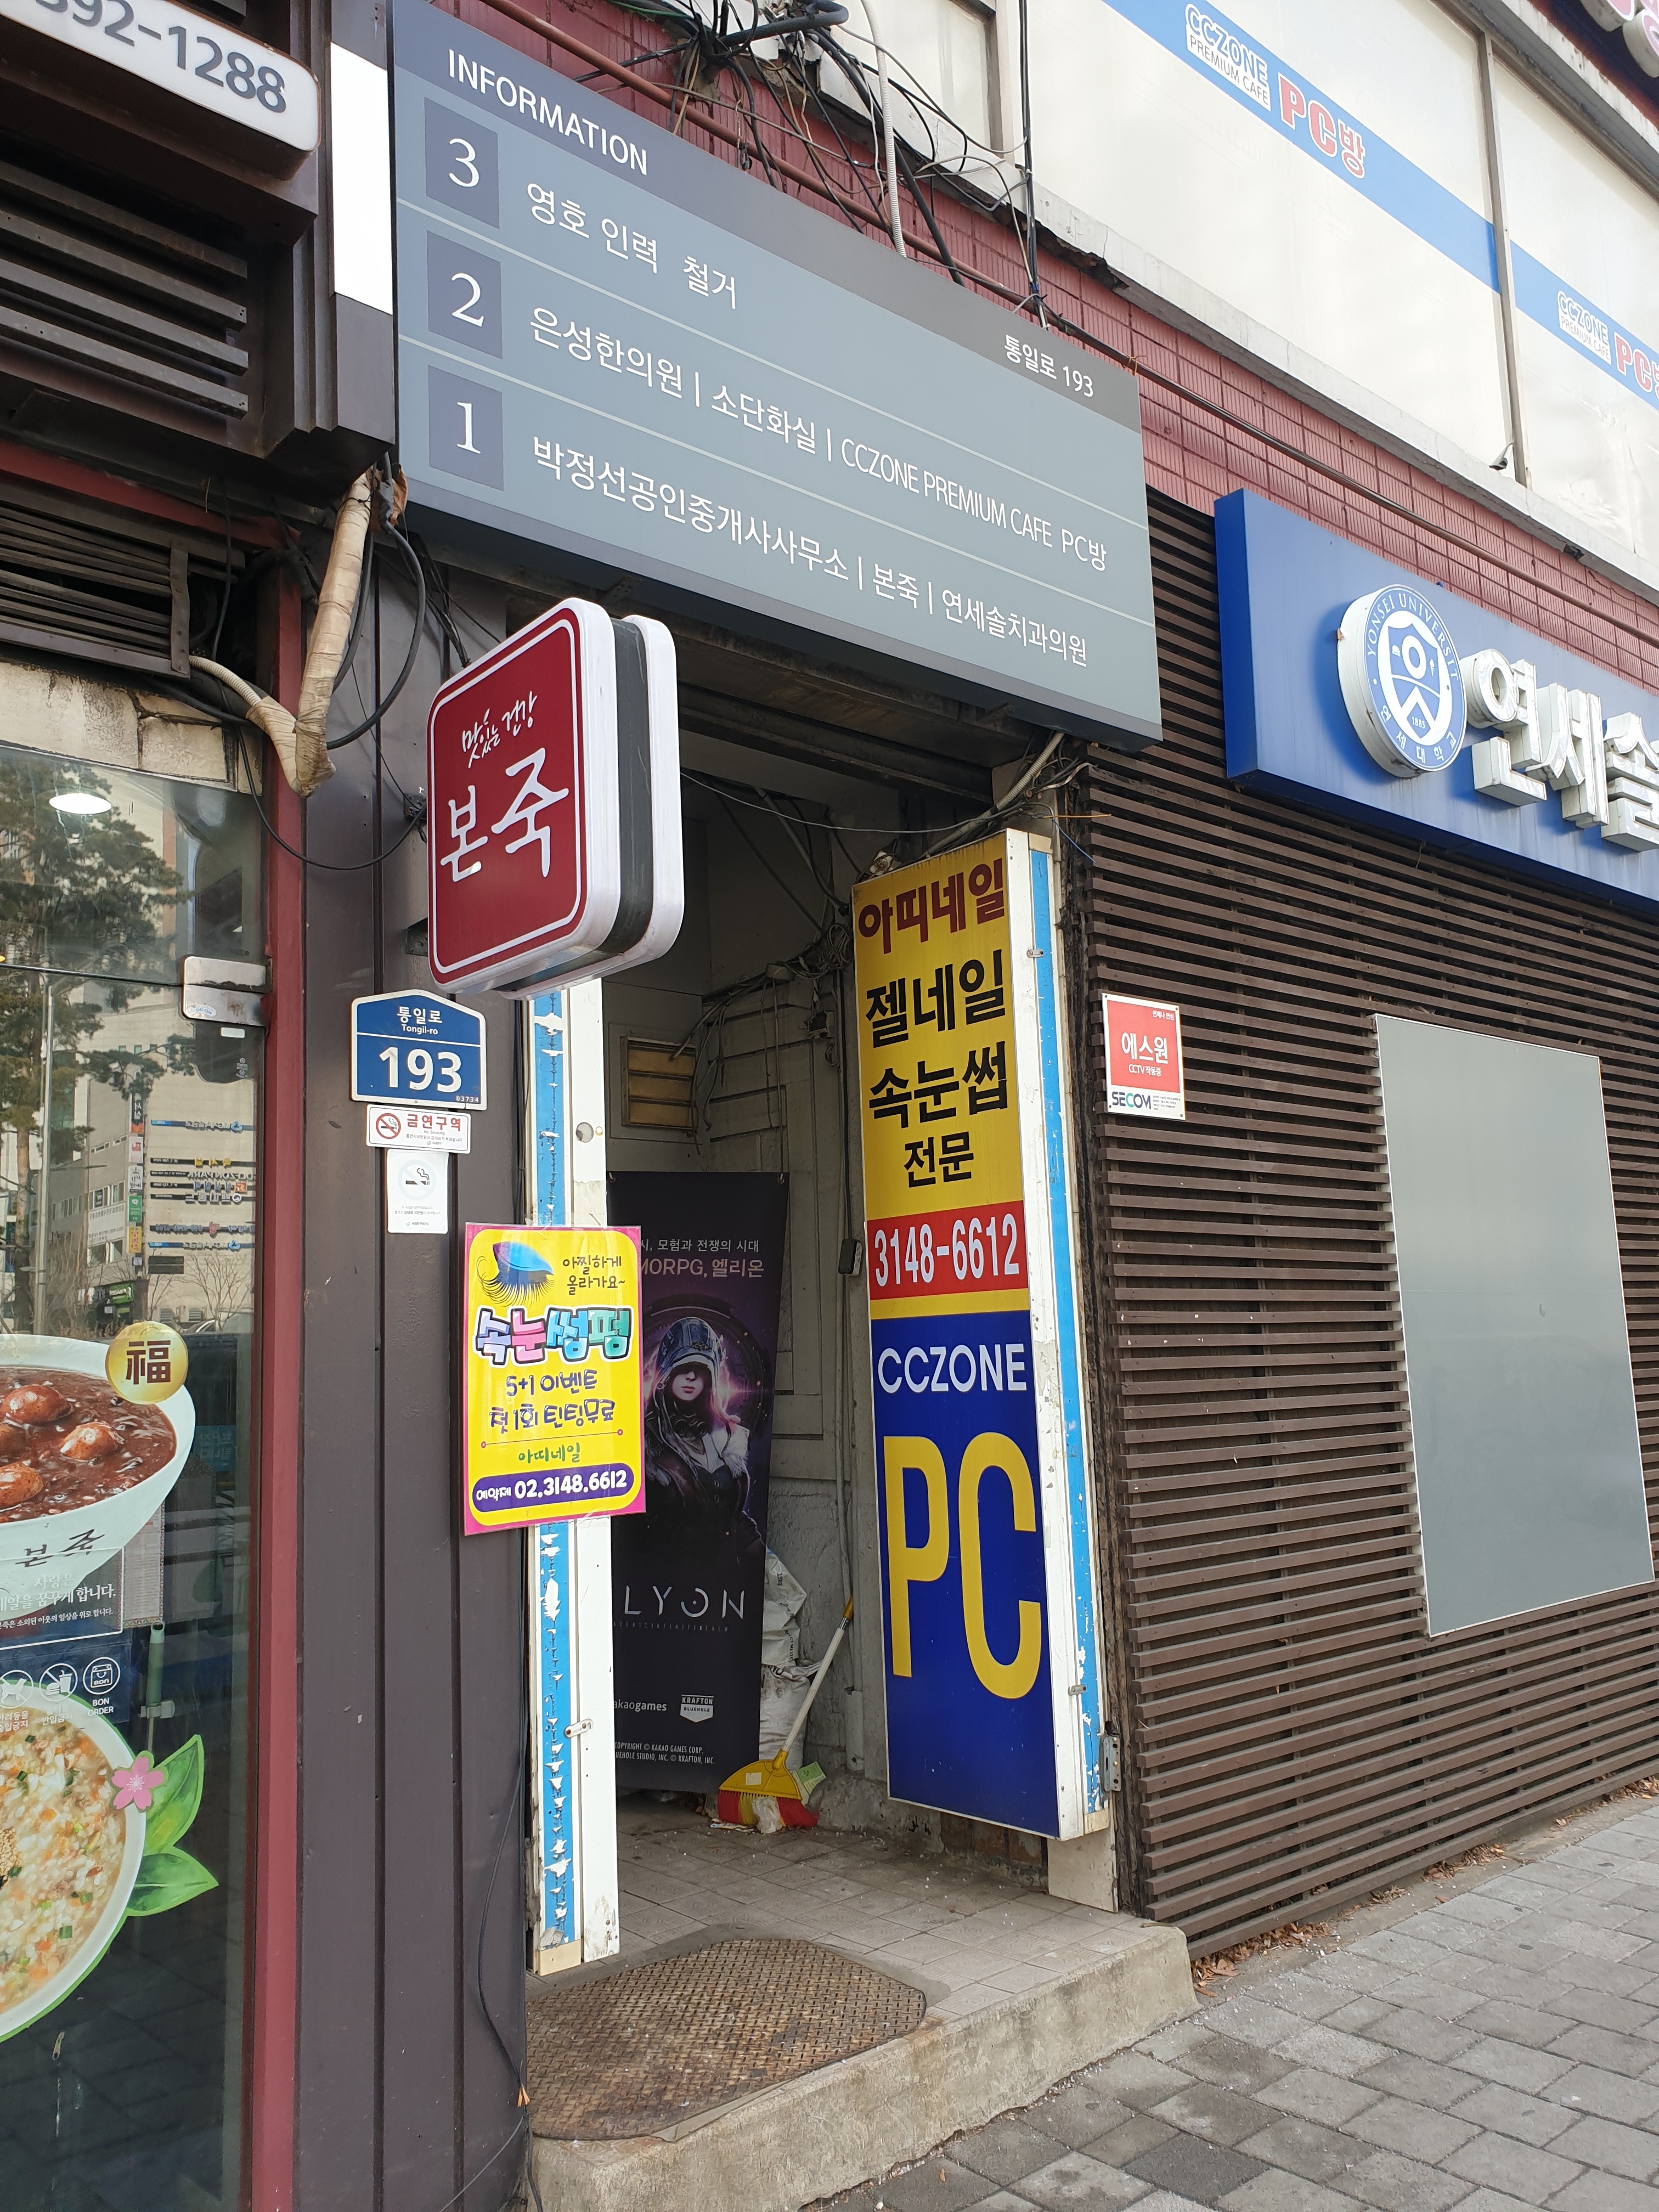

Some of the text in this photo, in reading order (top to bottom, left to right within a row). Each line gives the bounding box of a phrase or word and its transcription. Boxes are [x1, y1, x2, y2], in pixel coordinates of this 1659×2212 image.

[1185, 3, 1268, 88] CCZONE
[1190, 34, 1269, 106] PREMIUM CAFE
[448, 49, 647, 176] INFORMATION
[1278, 72, 1365, 179] PC방
[448, 138, 480, 188] 3
[527, 182, 736, 310] 영호 인력 철거
[451, 272, 485, 327] 2
[1557, 291, 1609, 346] CCZONE
[1561, 315, 1610, 360] PREMIUM CAFE
[1005, 334, 1094, 398] 통일로 193
[456, 402, 481, 454] 1
[530, 308, 1107, 572] 은성한의원 소단화실 CCZONE PREMIUM CAFE PC방
[533, 437, 1087, 668] 박정선공인중개사사무소 본죽 연세솔치과의원
[1367, 594, 1396, 657] YONSEI
[501, 690, 538, 737] 건강
[1380, 704, 1457, 765] 연세대학교
[1412, 716, 1426, 729] 1885
[440, 747, 569, 883] 본죽
[858, 857, 1005, 955] 아띠네일
[397, 1006, 443, 1025] 통일로
[865, 949, 1006, 1048] 젤네일
[1152, 1010, 1175, 1021] 언제나 안심
[401, 1024, 439, 1035] Tongil-ro
[1121, 1031, 1169, 1064] 에스원
[379, 1047, 462, 1093] 193
[868, 1040, 1008, 1130] 속눈썹
[1128, 1063, 1162, 1077] CCTV 작동중
[455, 1095, 479, 1103] 03734
[1111, 1091, 1152, 1110] SECOM
[407, 1113, 461, 1132] 금연구역
[903, 1131, 974, 1189] 전문
[562, 1255, 622, 1275] 아찔하게
[657, 1238, 692, 1251] 모험과
[697, 1239, 731, 1252] 전쟁의
[736, 1240, 759, 1252] 시대
[874, 1213, 1019, 1288] 3148-6612
[567, 1275, 626, 1296] 올라가요~
[712, 1259, 764, 1278] 엘리온
[126, 1340, 172, 1385] 福
[505, 1369, 597, 1397] 5+1 이벤트
[878, 1342, 1028, 1395] CCZONE
[543, 1398, 616, 1429] 틴팅무료
[518, 1442, 581, 1464] 아띠네일
[476, 1469, 627, 1502] 예약제 02.3148.6612
[15, 1528, 105, 1567] 본죽
[883, 1431, 1041, 1701] PC
[16, 1617, 37, 1627] 소외된
[38, 1614, 57, 1624] 이웃의
[58, 1612, 78, 1621] 일상을
[78, 1610, 92, 1619] 위로
[93, 1607, 114, 1617] 합니다.
[36, 1590, 74, 1606] 꿈꾸게
[76, 1583, 116, 1604] 합니다.
[88, 1706, 114, 1717] ORDER
[92, 1697, 110, 1707] BON
[681, 1696, 713, 1705] KRAFTON
[636, 1752, 657, 1762] STUDIO,
[658, 1753, 669, 1762] INC.
[678, 1756, 703, 1764] KRAFTON,
